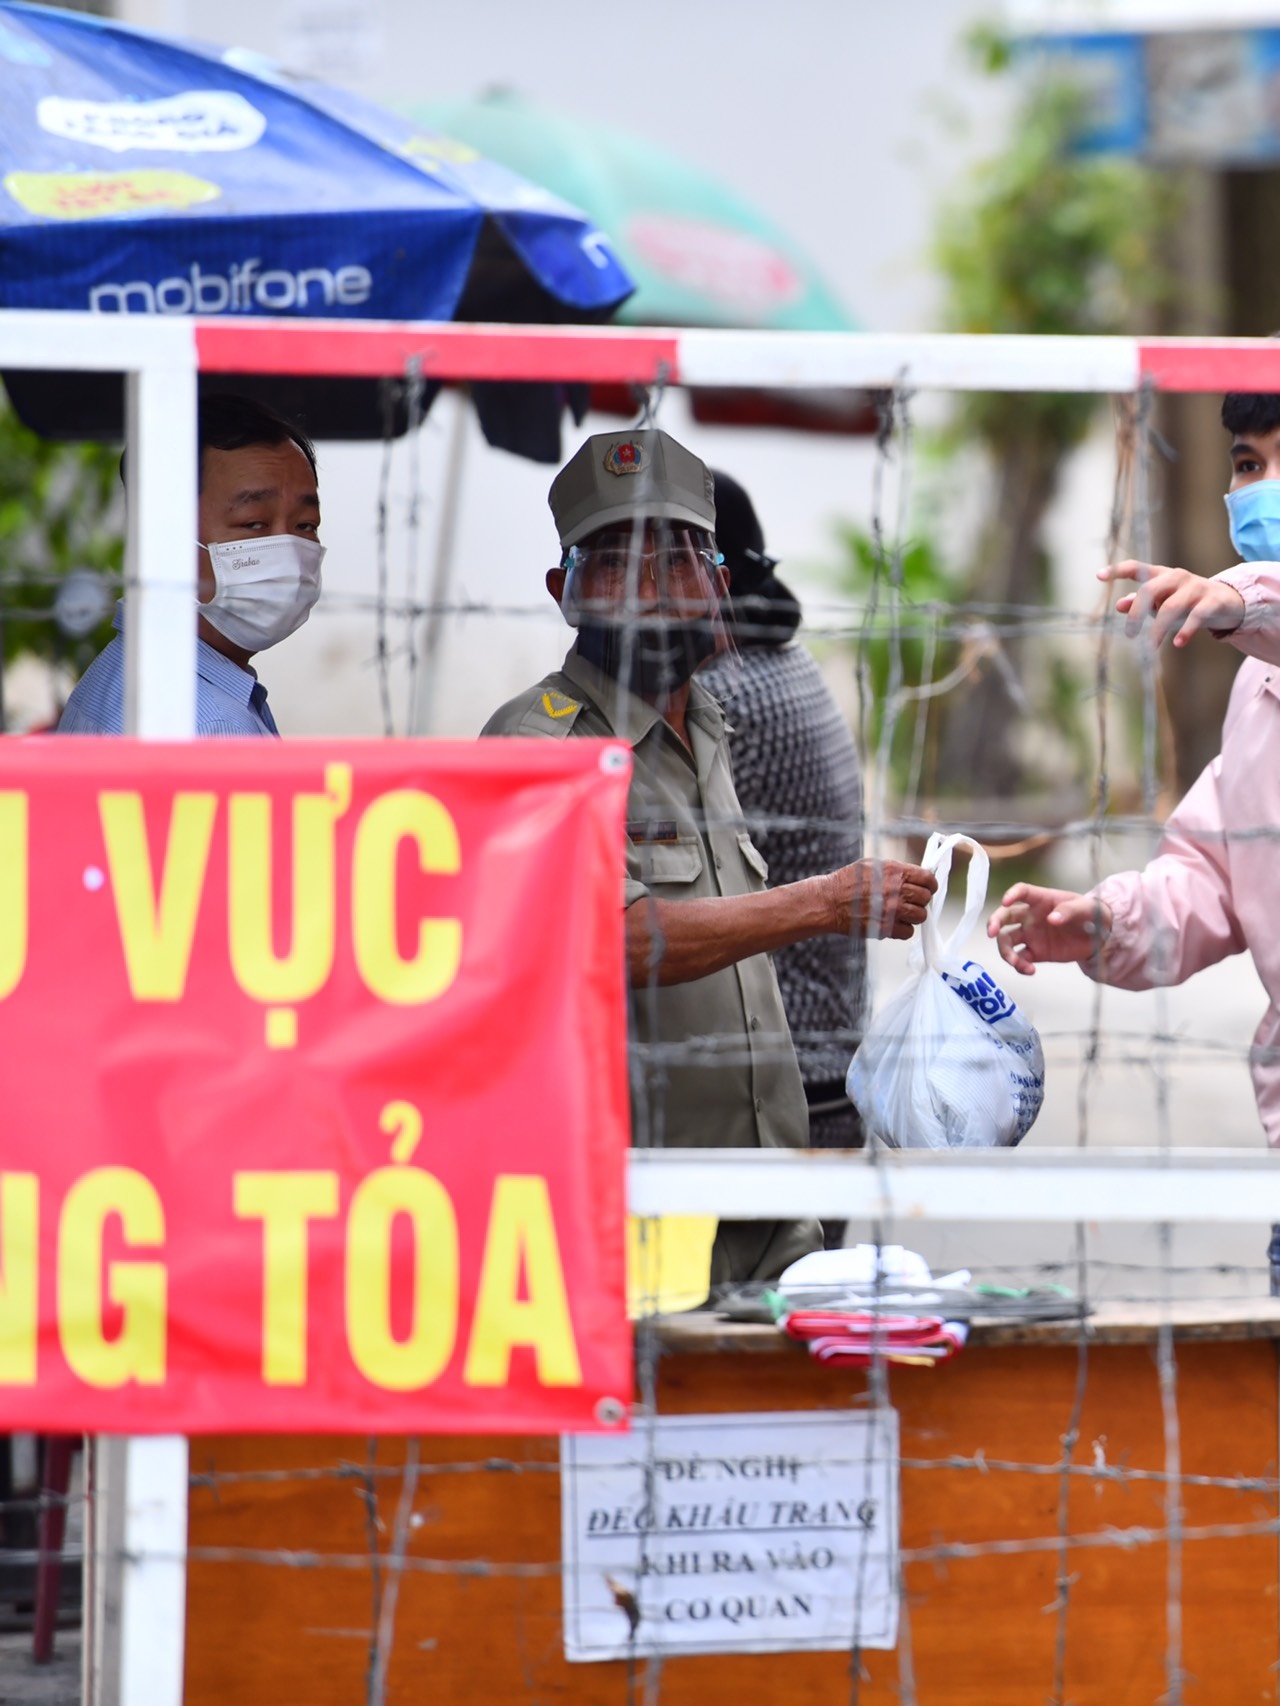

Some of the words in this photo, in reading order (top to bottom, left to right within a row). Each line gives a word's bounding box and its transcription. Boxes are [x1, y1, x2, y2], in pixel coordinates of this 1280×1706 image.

[89, 258, 372, 315] mobifone
[98, 761, 463, 1050] VỰC
[232, 1100, 583, 1392] TỎA
[712, 1552, 756, 1573] RA
[766, 1541, 835, 1571] VÀO
[721, 1594, 813, 1625] QUAN
